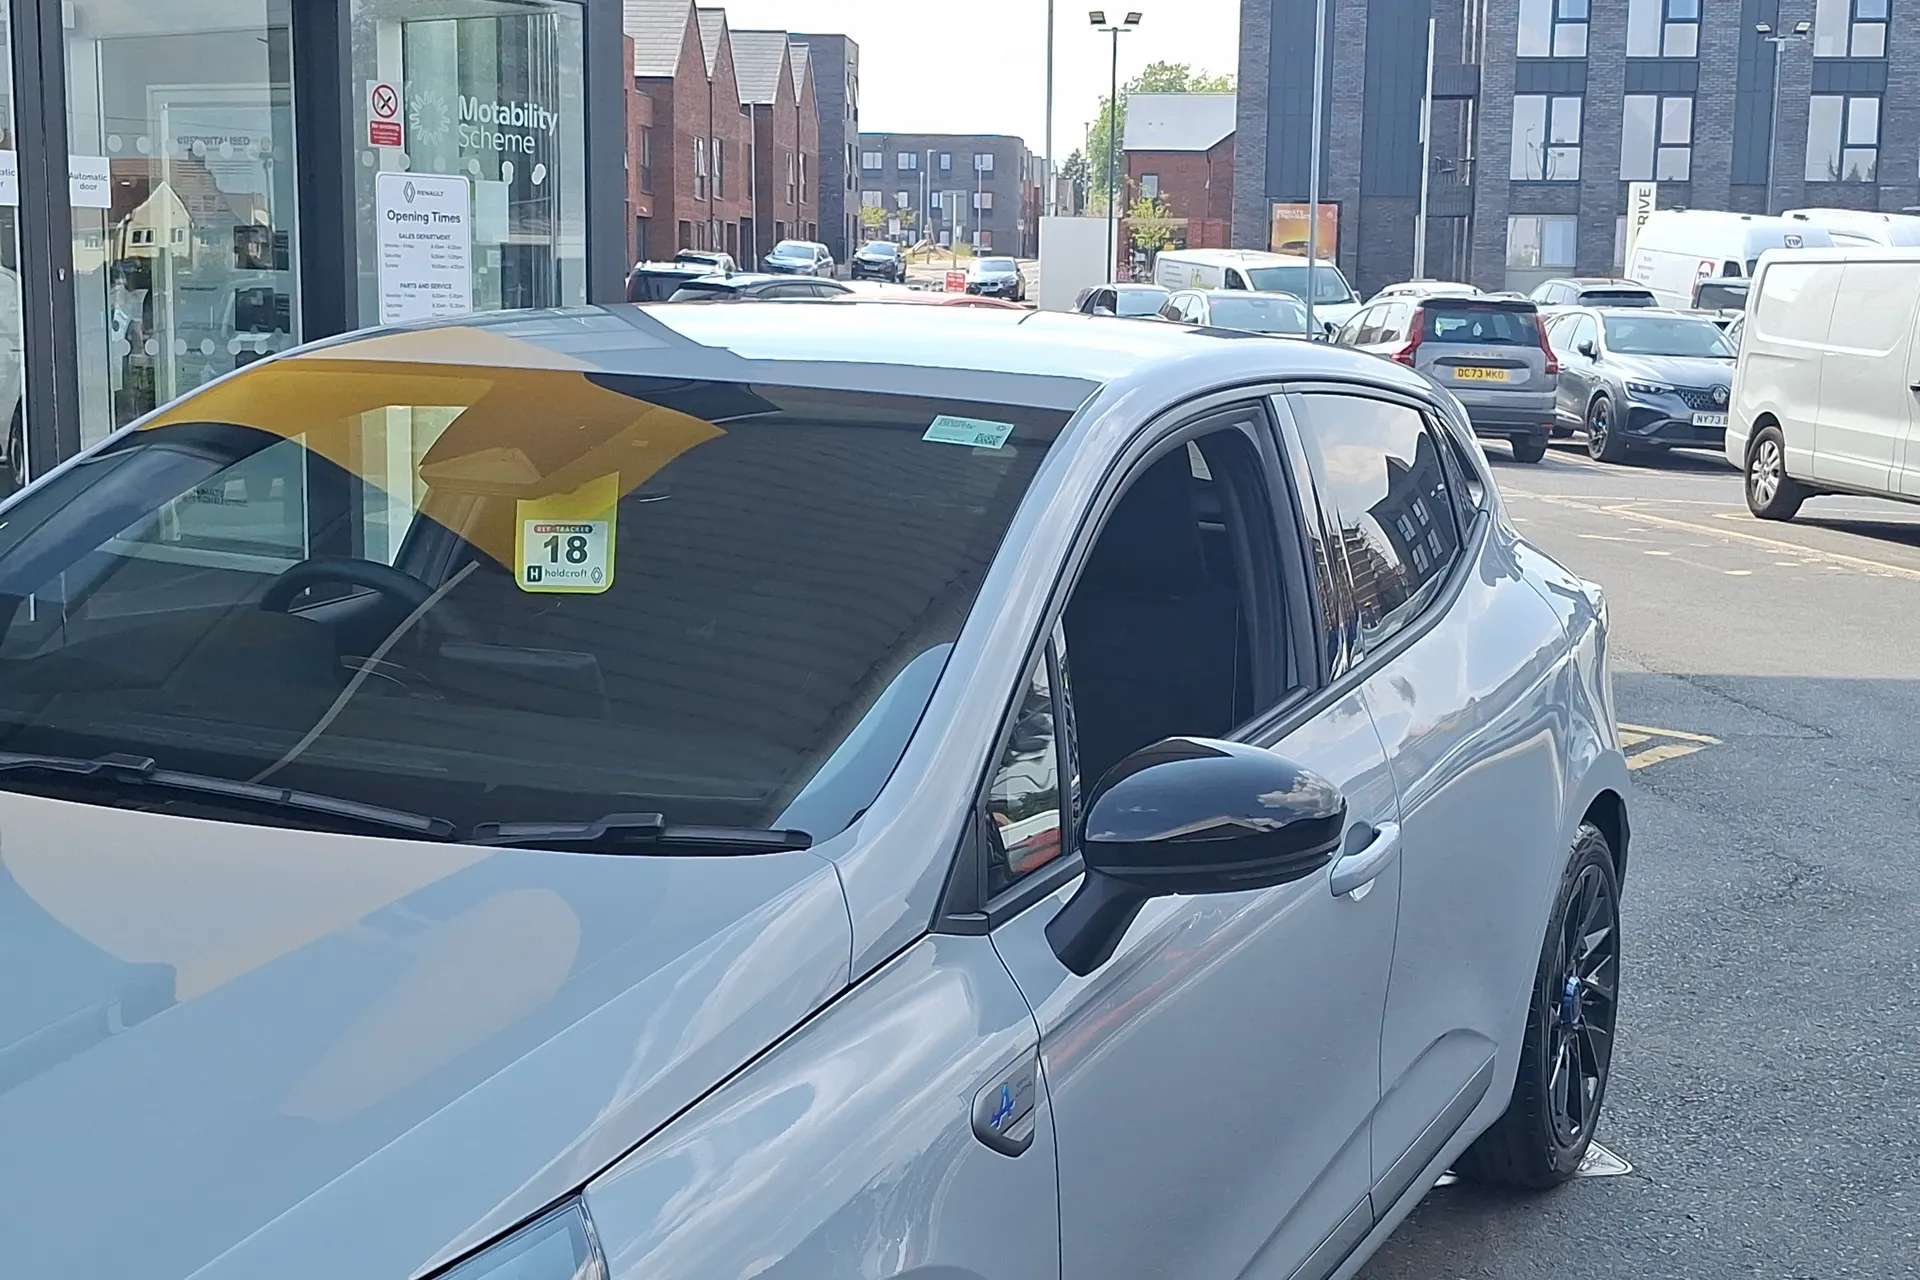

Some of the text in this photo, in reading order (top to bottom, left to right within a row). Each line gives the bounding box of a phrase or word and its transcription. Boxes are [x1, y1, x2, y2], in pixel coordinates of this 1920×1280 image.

[459, 95, 558, 137] Motability
[459, 123, 536, 154] Scheme
[69, 171, 108, 182] Automatic
[79, 182, 98, 190] door
[416, 189, 444, 197] RENAULT
[386, 209, 461, 225] Opening Times
[1457, 368, 1484, 379] DC73
[543, 535, 588, 564] 18
[544, 568, 588, 578] holdcroft
